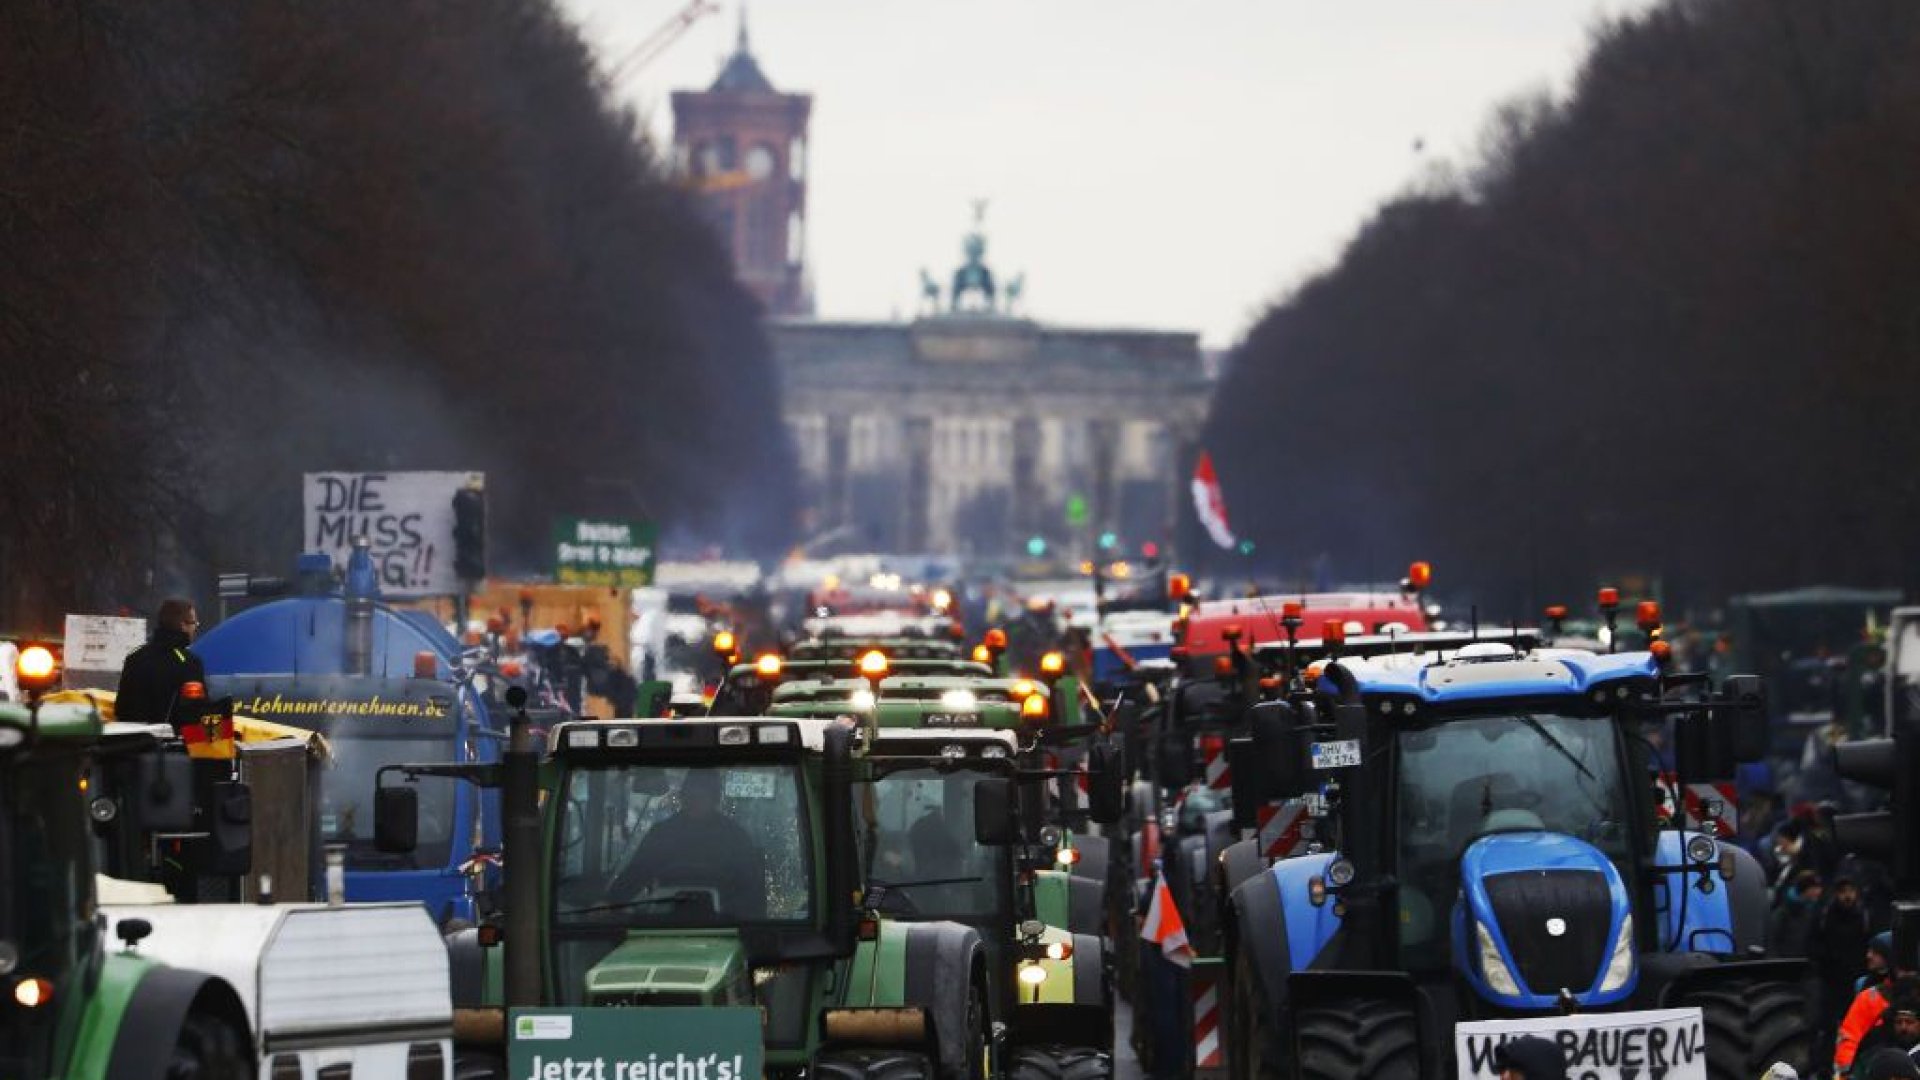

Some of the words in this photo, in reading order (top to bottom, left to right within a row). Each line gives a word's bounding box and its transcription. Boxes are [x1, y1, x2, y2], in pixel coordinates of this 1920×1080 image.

[315, 475, 387, 512] DIE
[316, 513, 423, 549] MUSS
[527, 1054, 605, 1080] Jetzt
